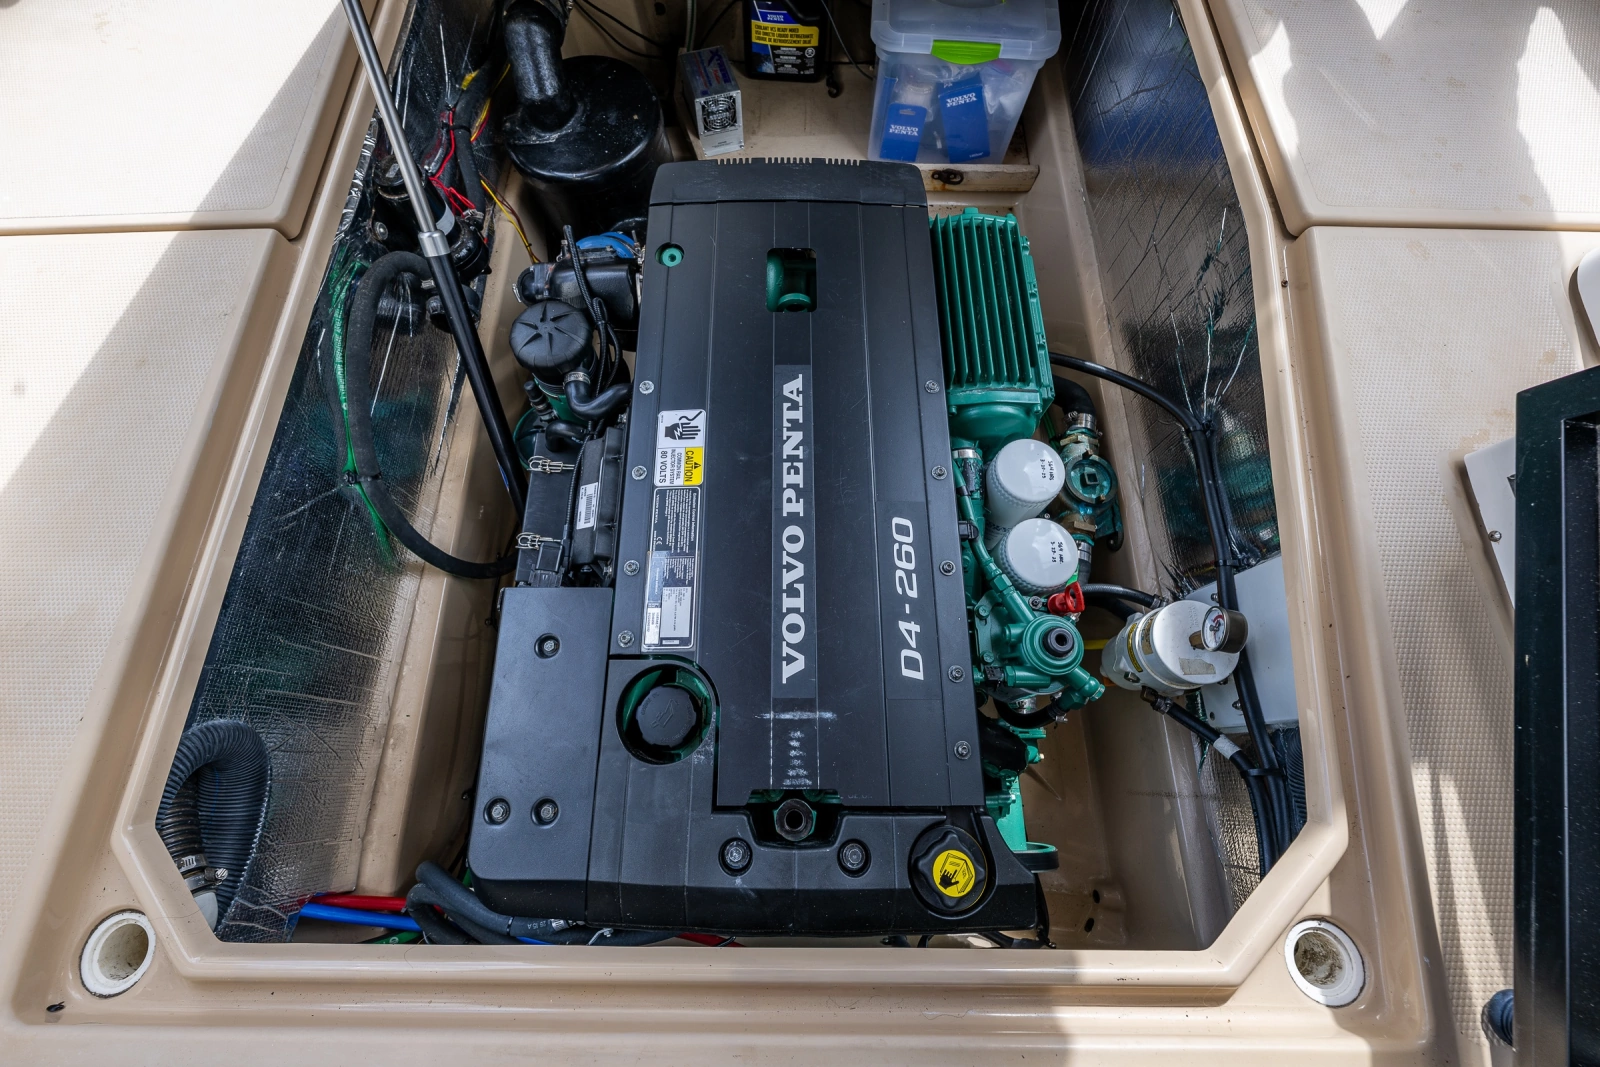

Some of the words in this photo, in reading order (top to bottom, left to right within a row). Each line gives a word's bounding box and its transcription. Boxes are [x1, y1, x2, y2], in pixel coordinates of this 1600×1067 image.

[946, 92, 976, 103] VOLVO
[946, 97, 977, 108] PENTA
[660, 451, 668, 459] 80
[782, 374, 804, 517] PENTA
[659, 460, 667, 484] VOLTS
[685, 450, 694, 482] CAUTION
[782, 525, 805, 683] VOLVO
[891, 517, 924, 681] D4-260
